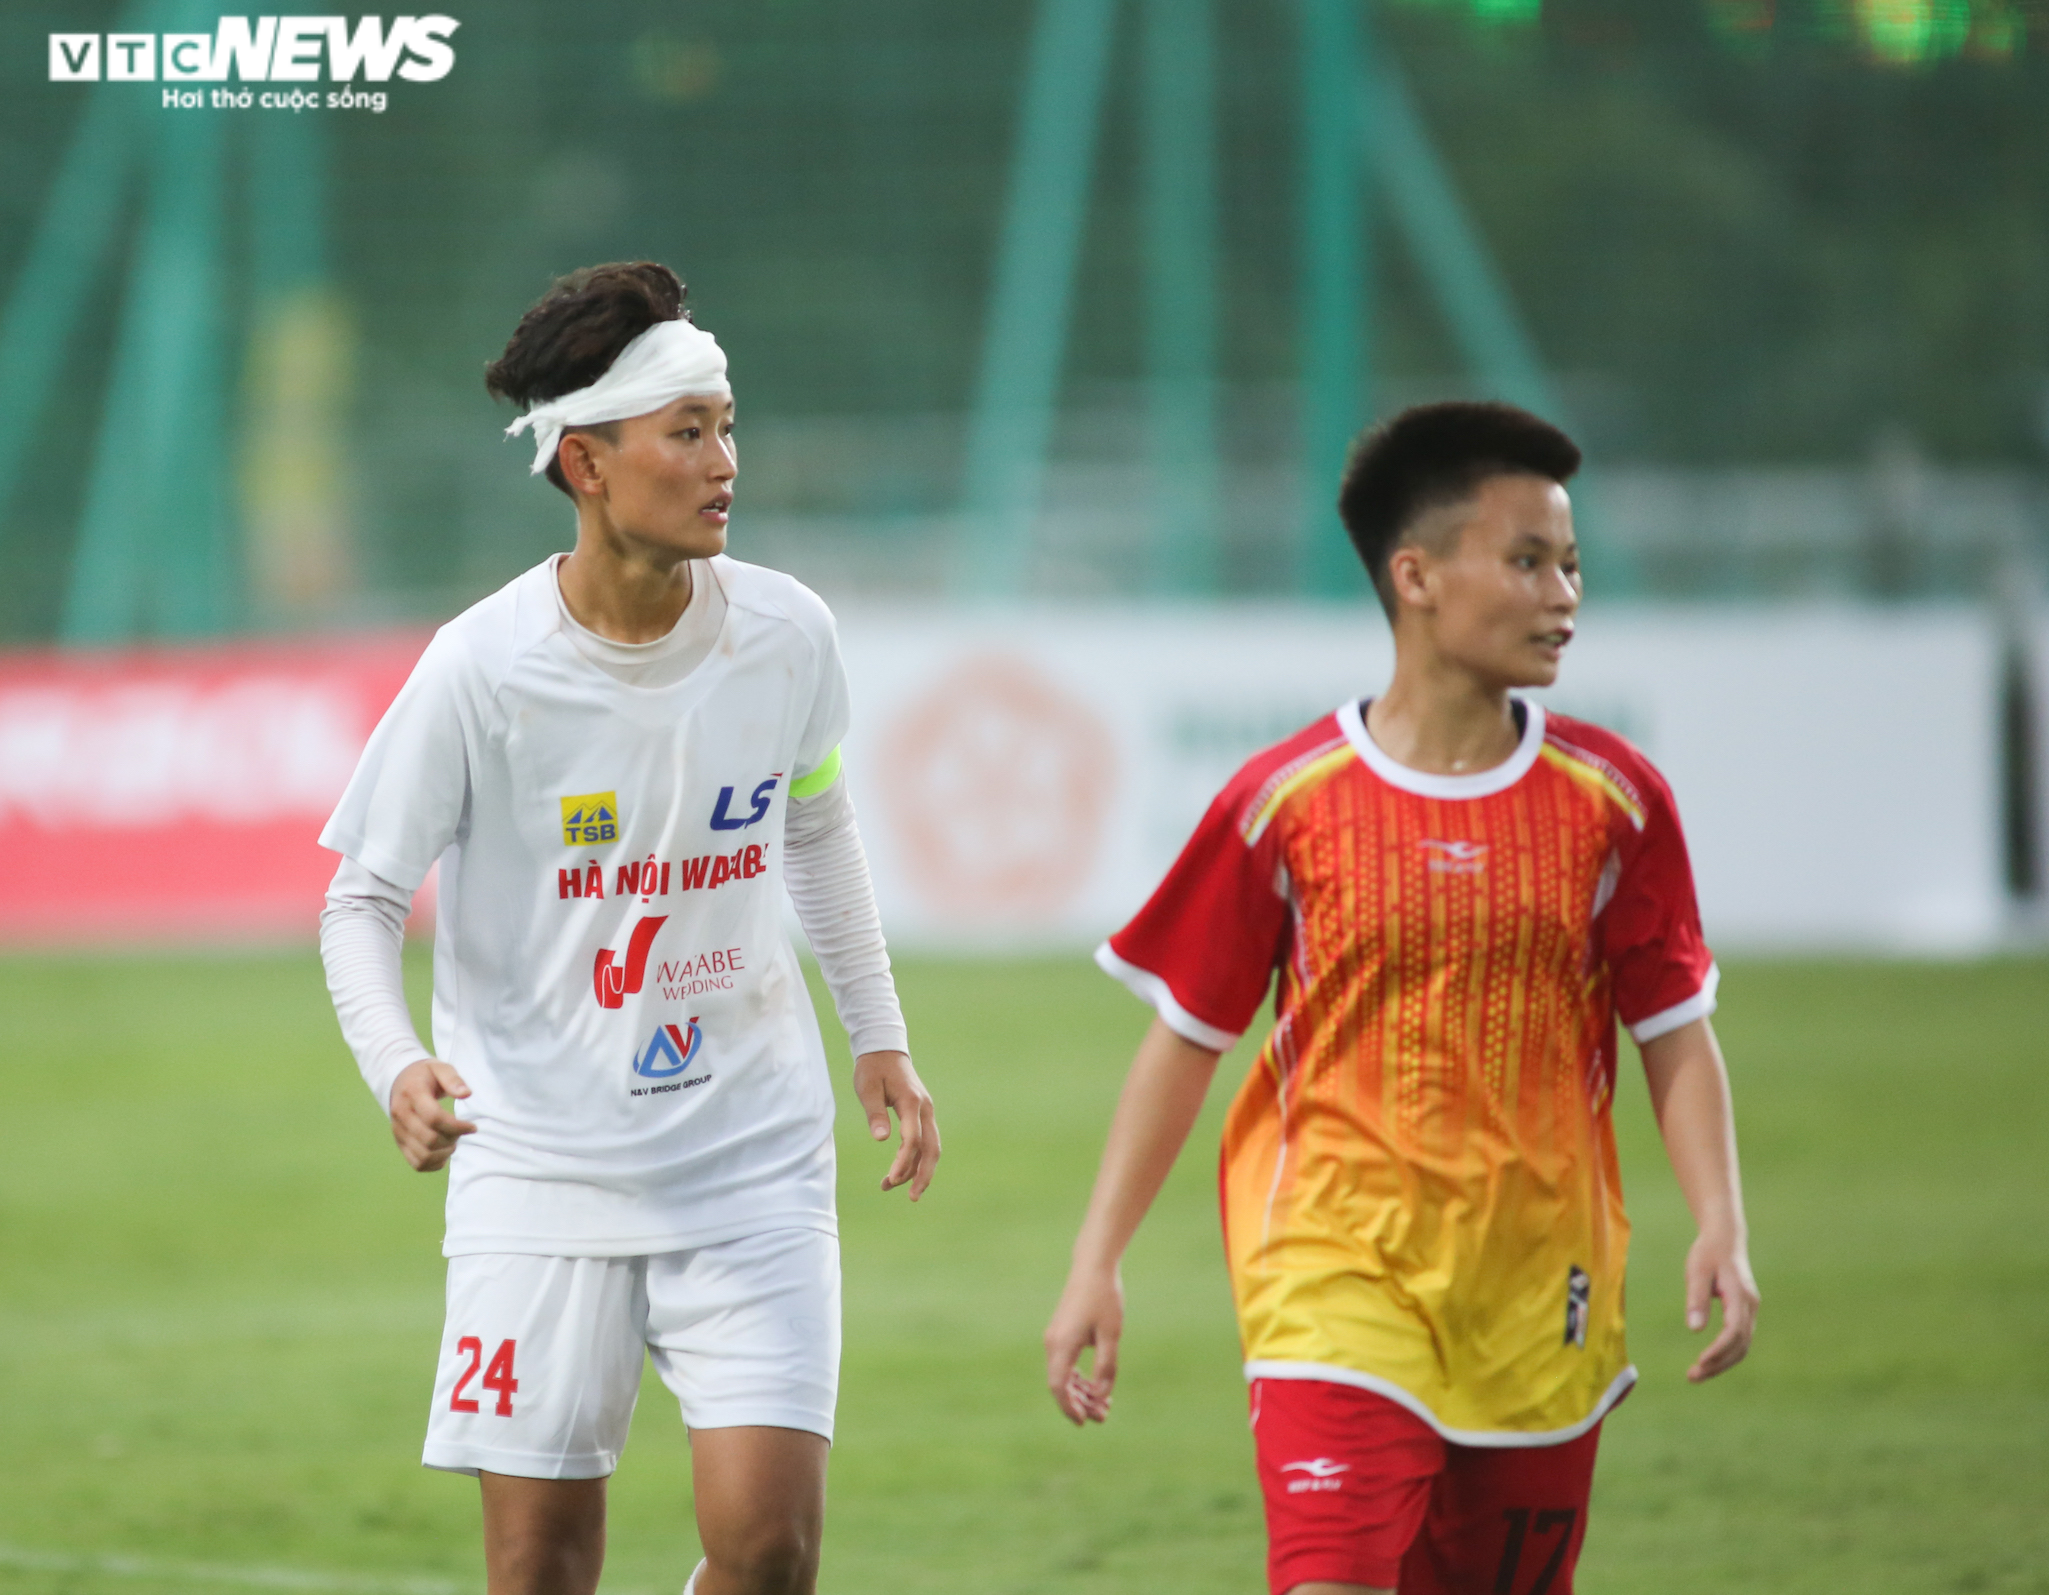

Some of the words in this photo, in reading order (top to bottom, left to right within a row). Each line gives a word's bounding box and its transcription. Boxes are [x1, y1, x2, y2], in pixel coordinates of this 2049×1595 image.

[565, 823, 617, 843] TSB
[558, 859, 605, 900] HÀ
[616, 853, 670, 904] NỘI
[630, 1087, 649, 1097] N&V
[651, 1082, 682, 1095] BRIDGE
[683, 1074, 712, 1089] GROUP
[450, 1335, 519, 1418] 24
[1491, 1506, 1578, 1595] 17
